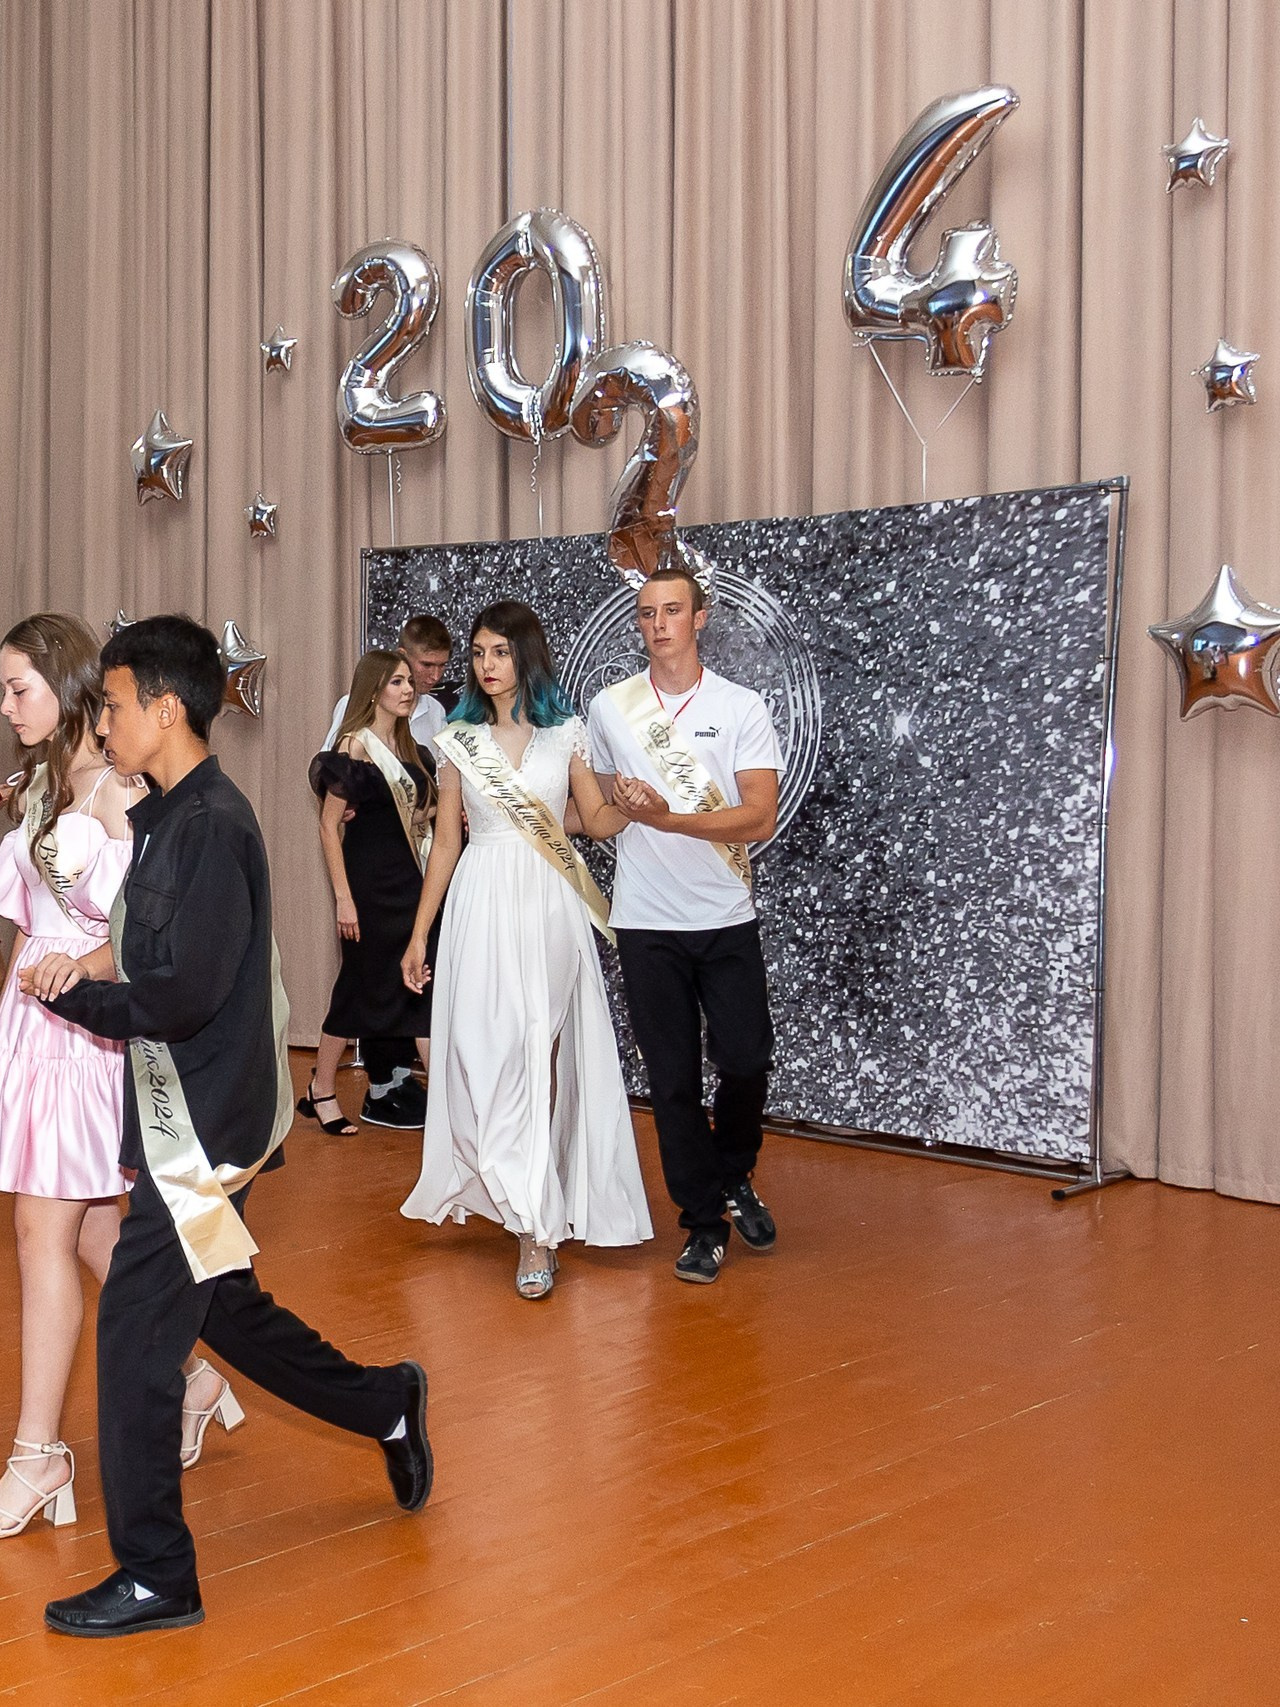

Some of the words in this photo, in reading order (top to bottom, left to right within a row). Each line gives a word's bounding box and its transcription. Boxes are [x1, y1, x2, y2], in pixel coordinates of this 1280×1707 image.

[694, 730, 716, 738] PUMA
[547, 841, 576, 870] 2024
[148, 1071, 180, 1141] 2024
